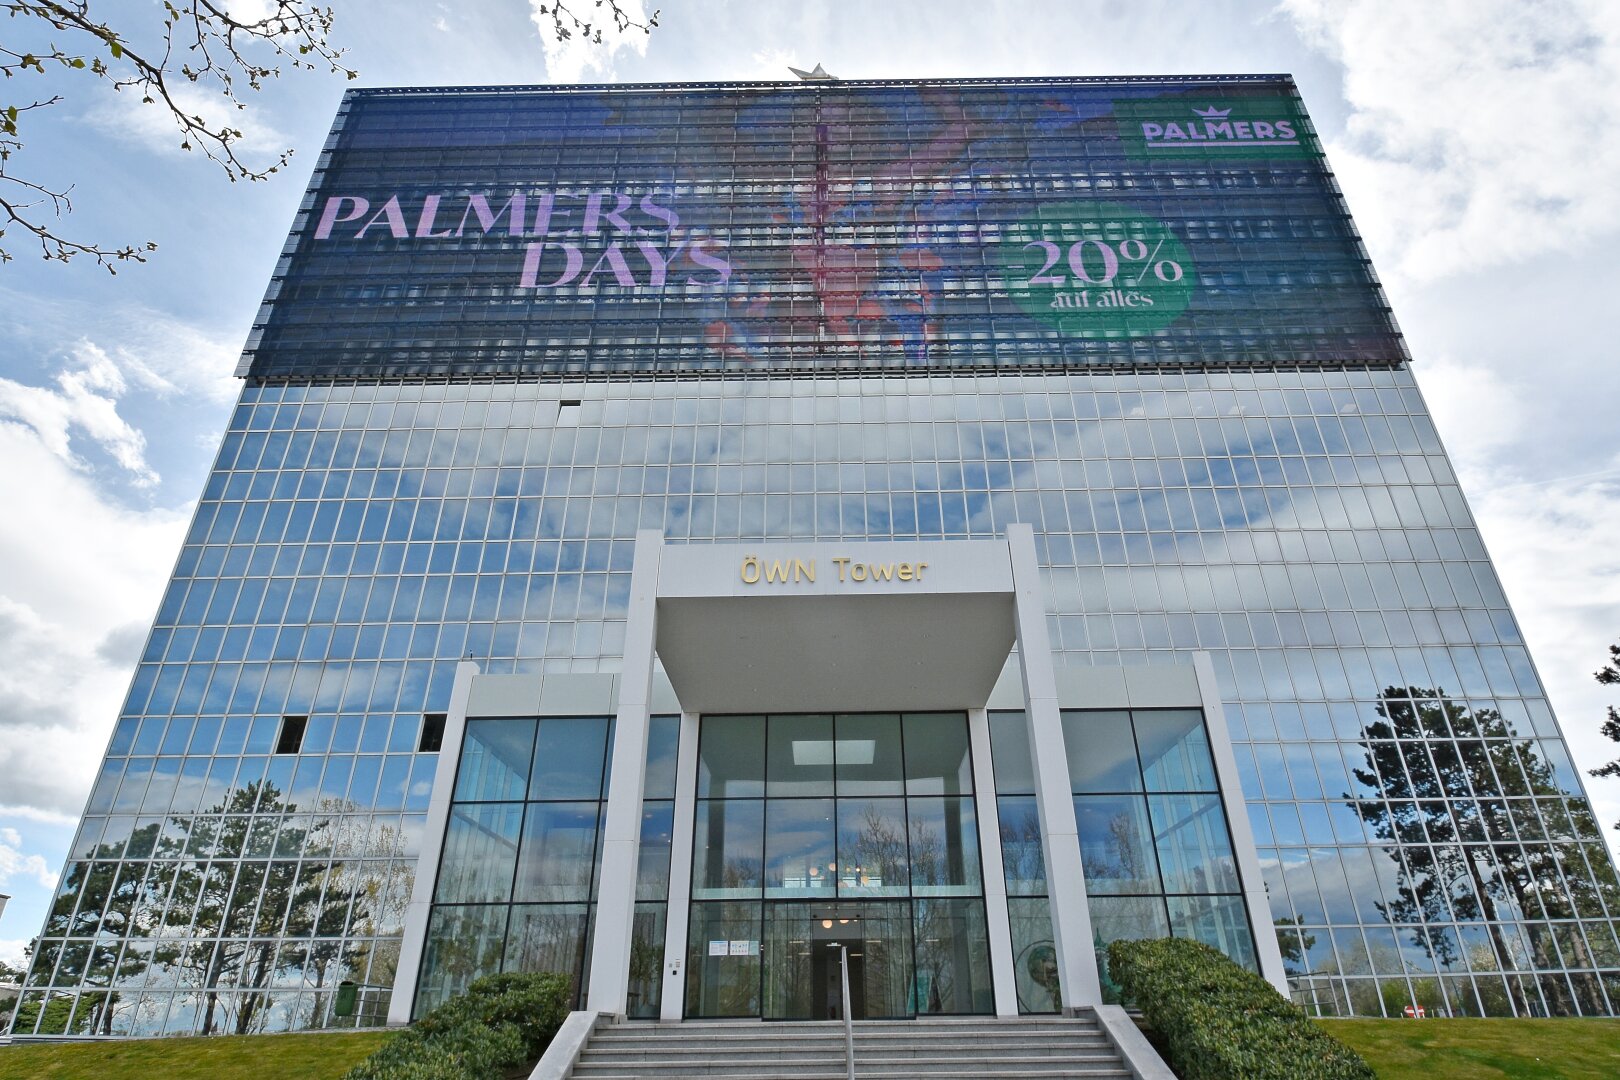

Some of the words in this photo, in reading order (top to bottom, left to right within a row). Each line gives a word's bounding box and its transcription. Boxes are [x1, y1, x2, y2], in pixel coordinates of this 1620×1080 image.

[1141, 121, 1297, 140] PALMERS
[314, 191, 680, 239] PALMERS
[518, 240, 732, 288] DAYS
[1050, 289, 1089, 308] auf
[1096, 289, 1153, 308] alles
[740, 555, 816, 584] ÖWN
[832, 557, 929, 582] Tower
